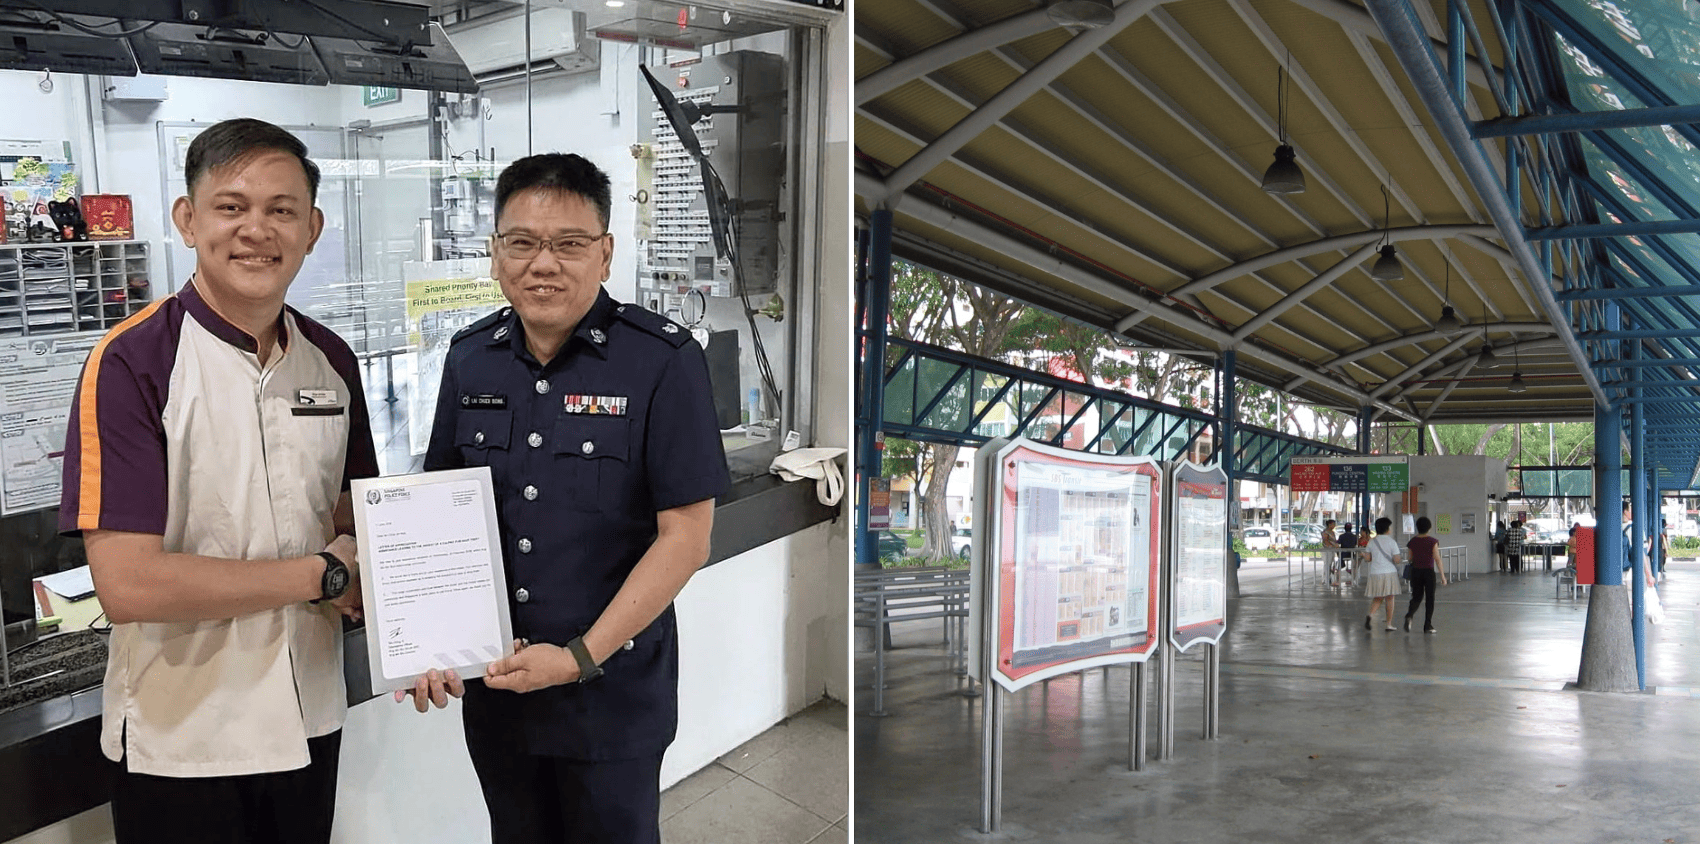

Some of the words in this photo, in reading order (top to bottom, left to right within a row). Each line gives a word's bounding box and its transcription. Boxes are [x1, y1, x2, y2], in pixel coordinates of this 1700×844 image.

[370, 86, 388, 100] EXIT
[424, 285, 450, 294] Shared
[412, 298, 430, 307] First
[431, 297, 439, 305] to
